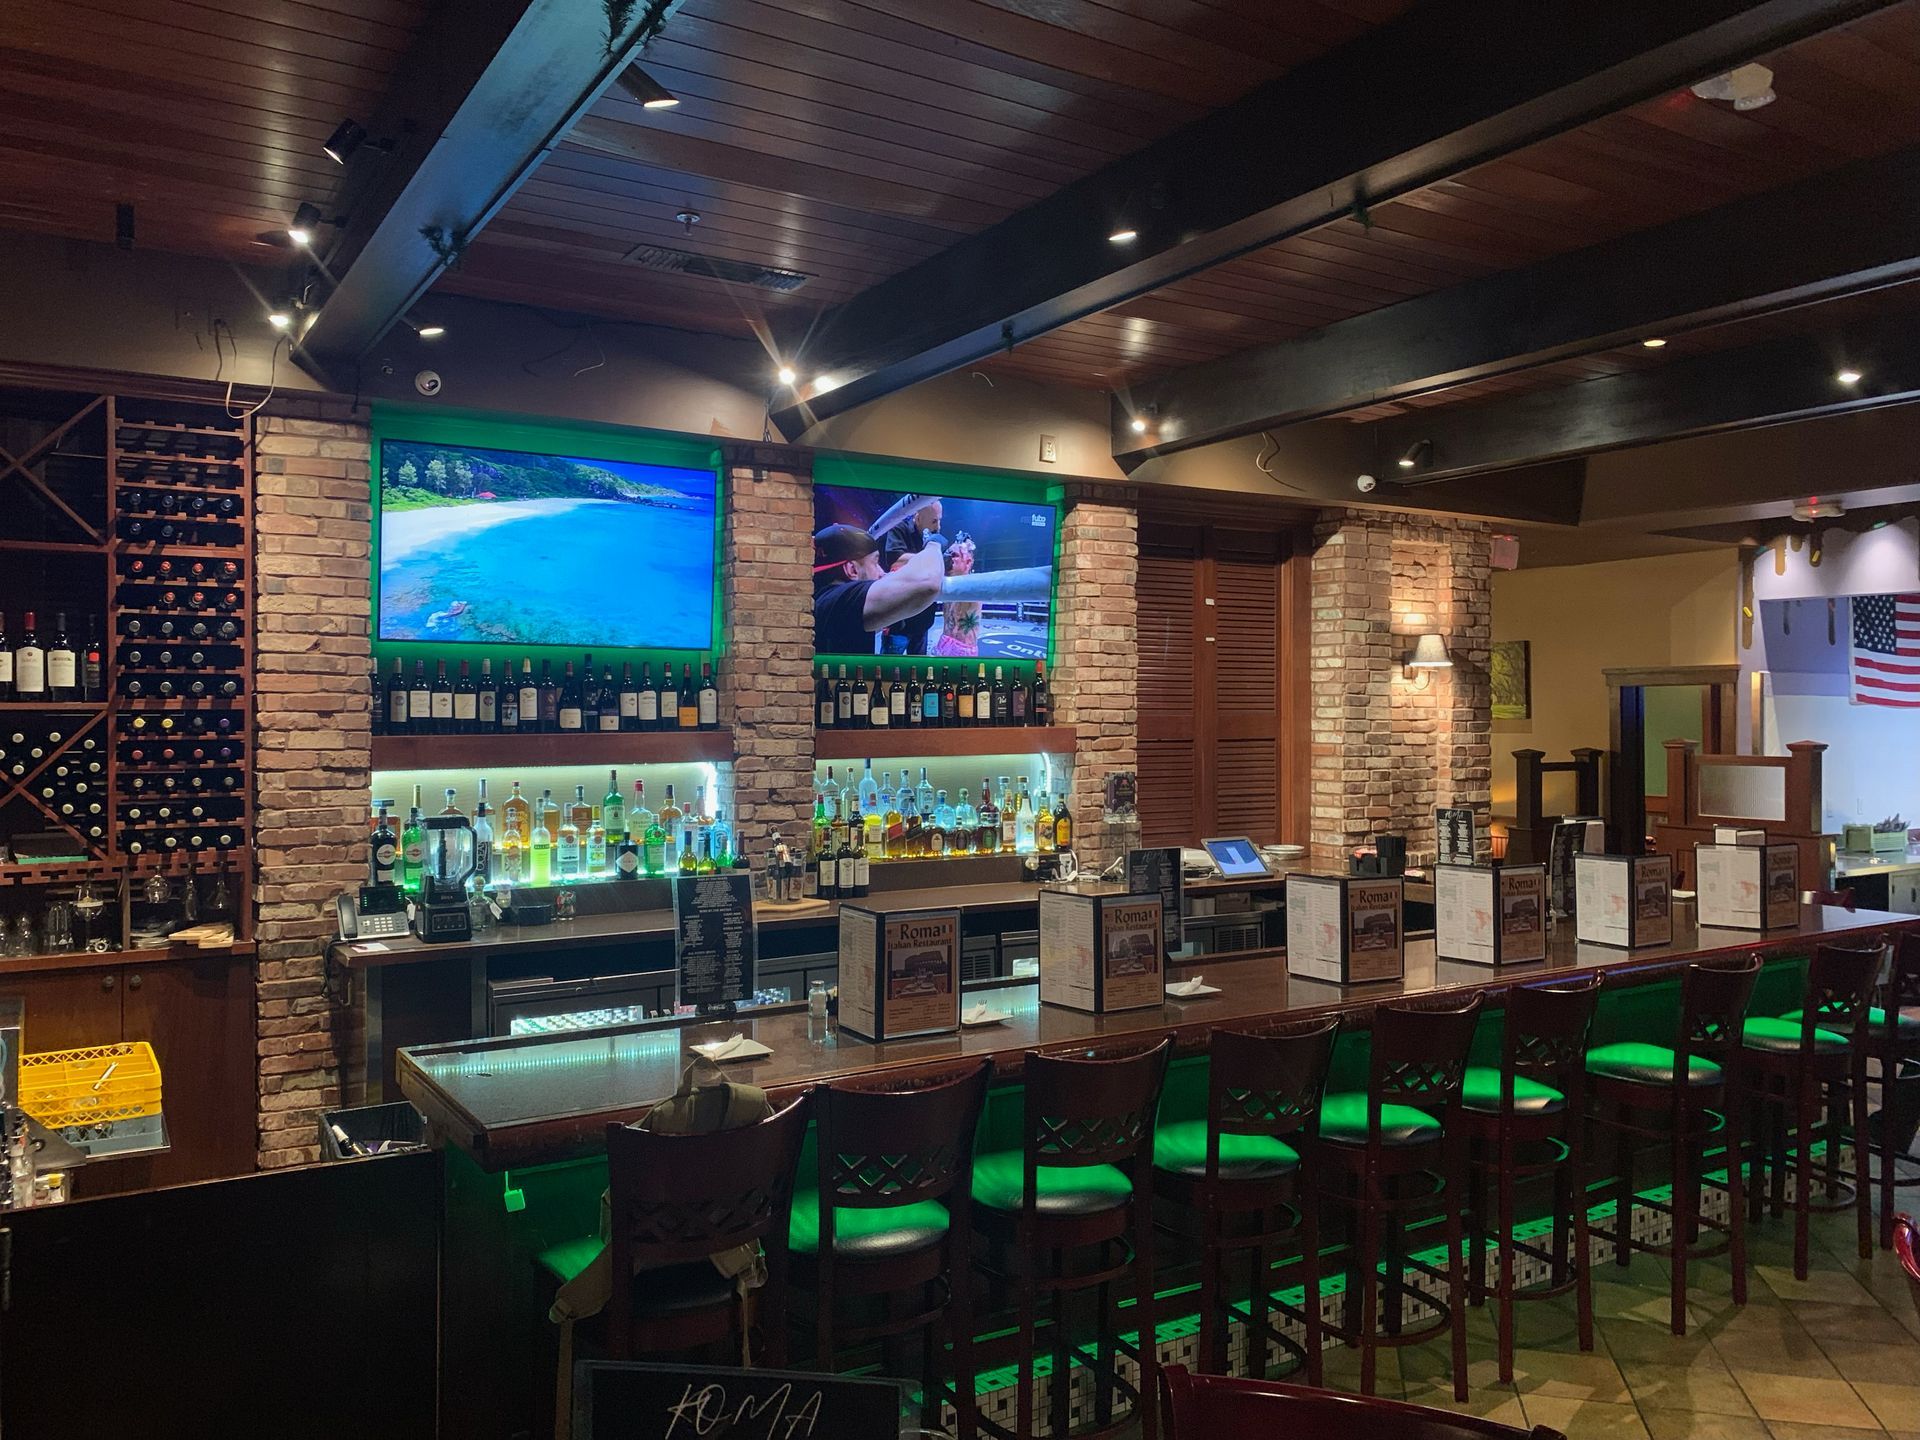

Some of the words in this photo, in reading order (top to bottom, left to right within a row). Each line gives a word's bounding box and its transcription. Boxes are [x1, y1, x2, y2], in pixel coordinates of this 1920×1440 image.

[1031, 513, 1046, 522] fubo
[1508, 877, 1534, 890] Roma
[1359, 890, 1389, 903] Roma
[1114, 908, 1148, 924] Roma
[900, 923, 941, 940] Roma
[887, 940, 911, 950] Italian
[913, 938, 952, 948] Restaurant
